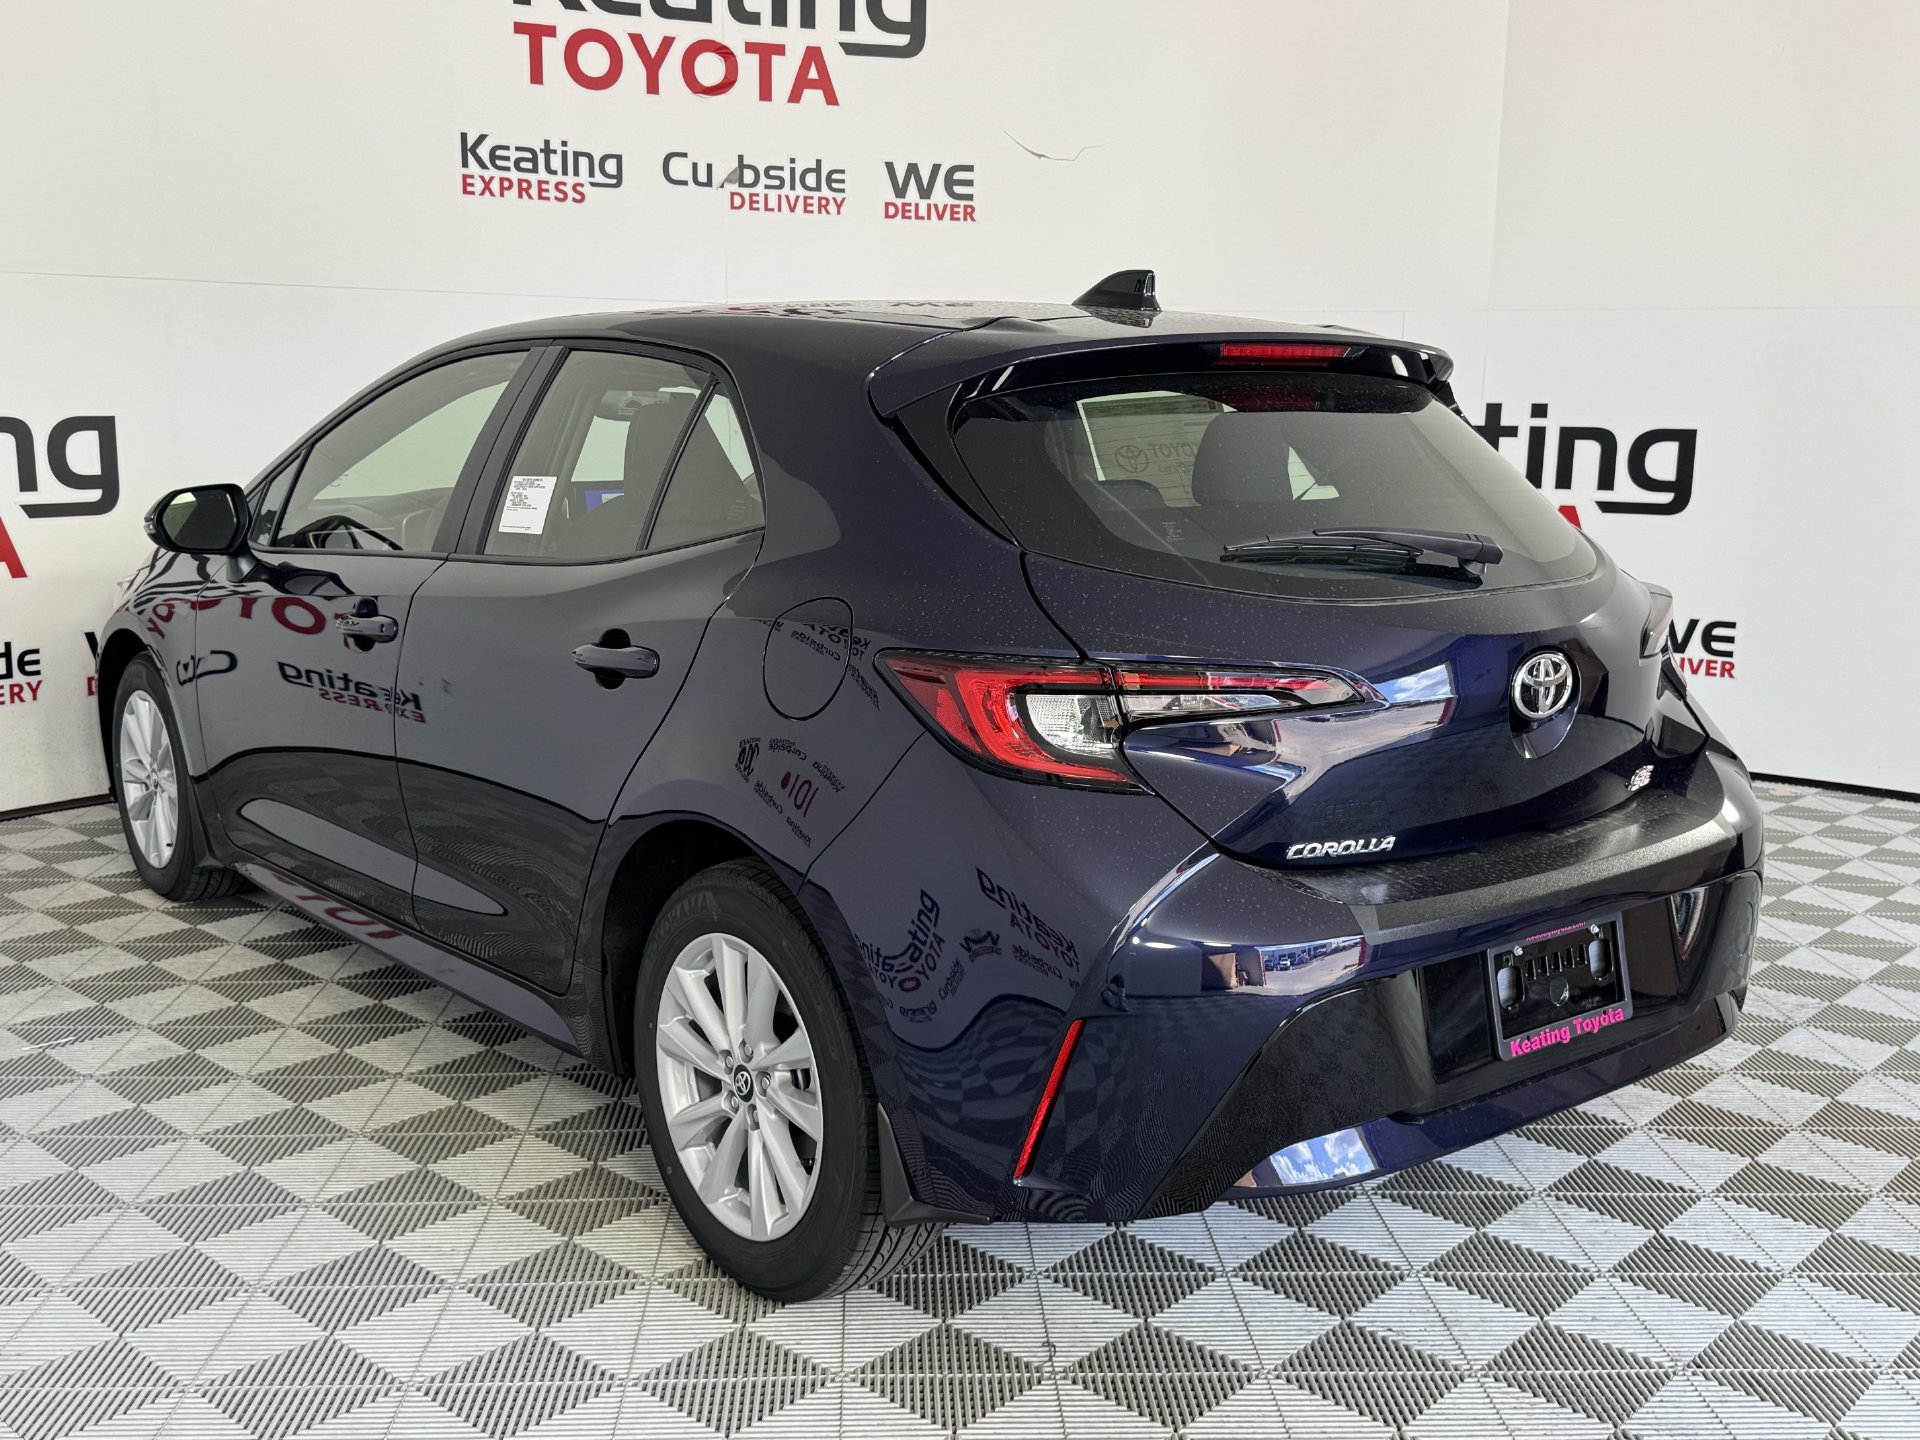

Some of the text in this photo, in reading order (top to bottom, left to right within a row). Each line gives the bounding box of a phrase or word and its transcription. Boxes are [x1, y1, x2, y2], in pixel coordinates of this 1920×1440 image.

[513, 21, 840, 107] TOYOTA
[460, 131, 975, 202] Keating Cubside WE
[462, 173, 976, 222] EXPRESS DELIVERY DELIVER
[0, 415, 120, 519] ng
[1473, 402, 1698, 516] ting
[0, 641, 42, 680] de
[1680, 657, 1736, 679] IVER
[1285, 835, 1396, 861] COROLLA
[1510, 1008, 1625, 1058] Keating Toyota
